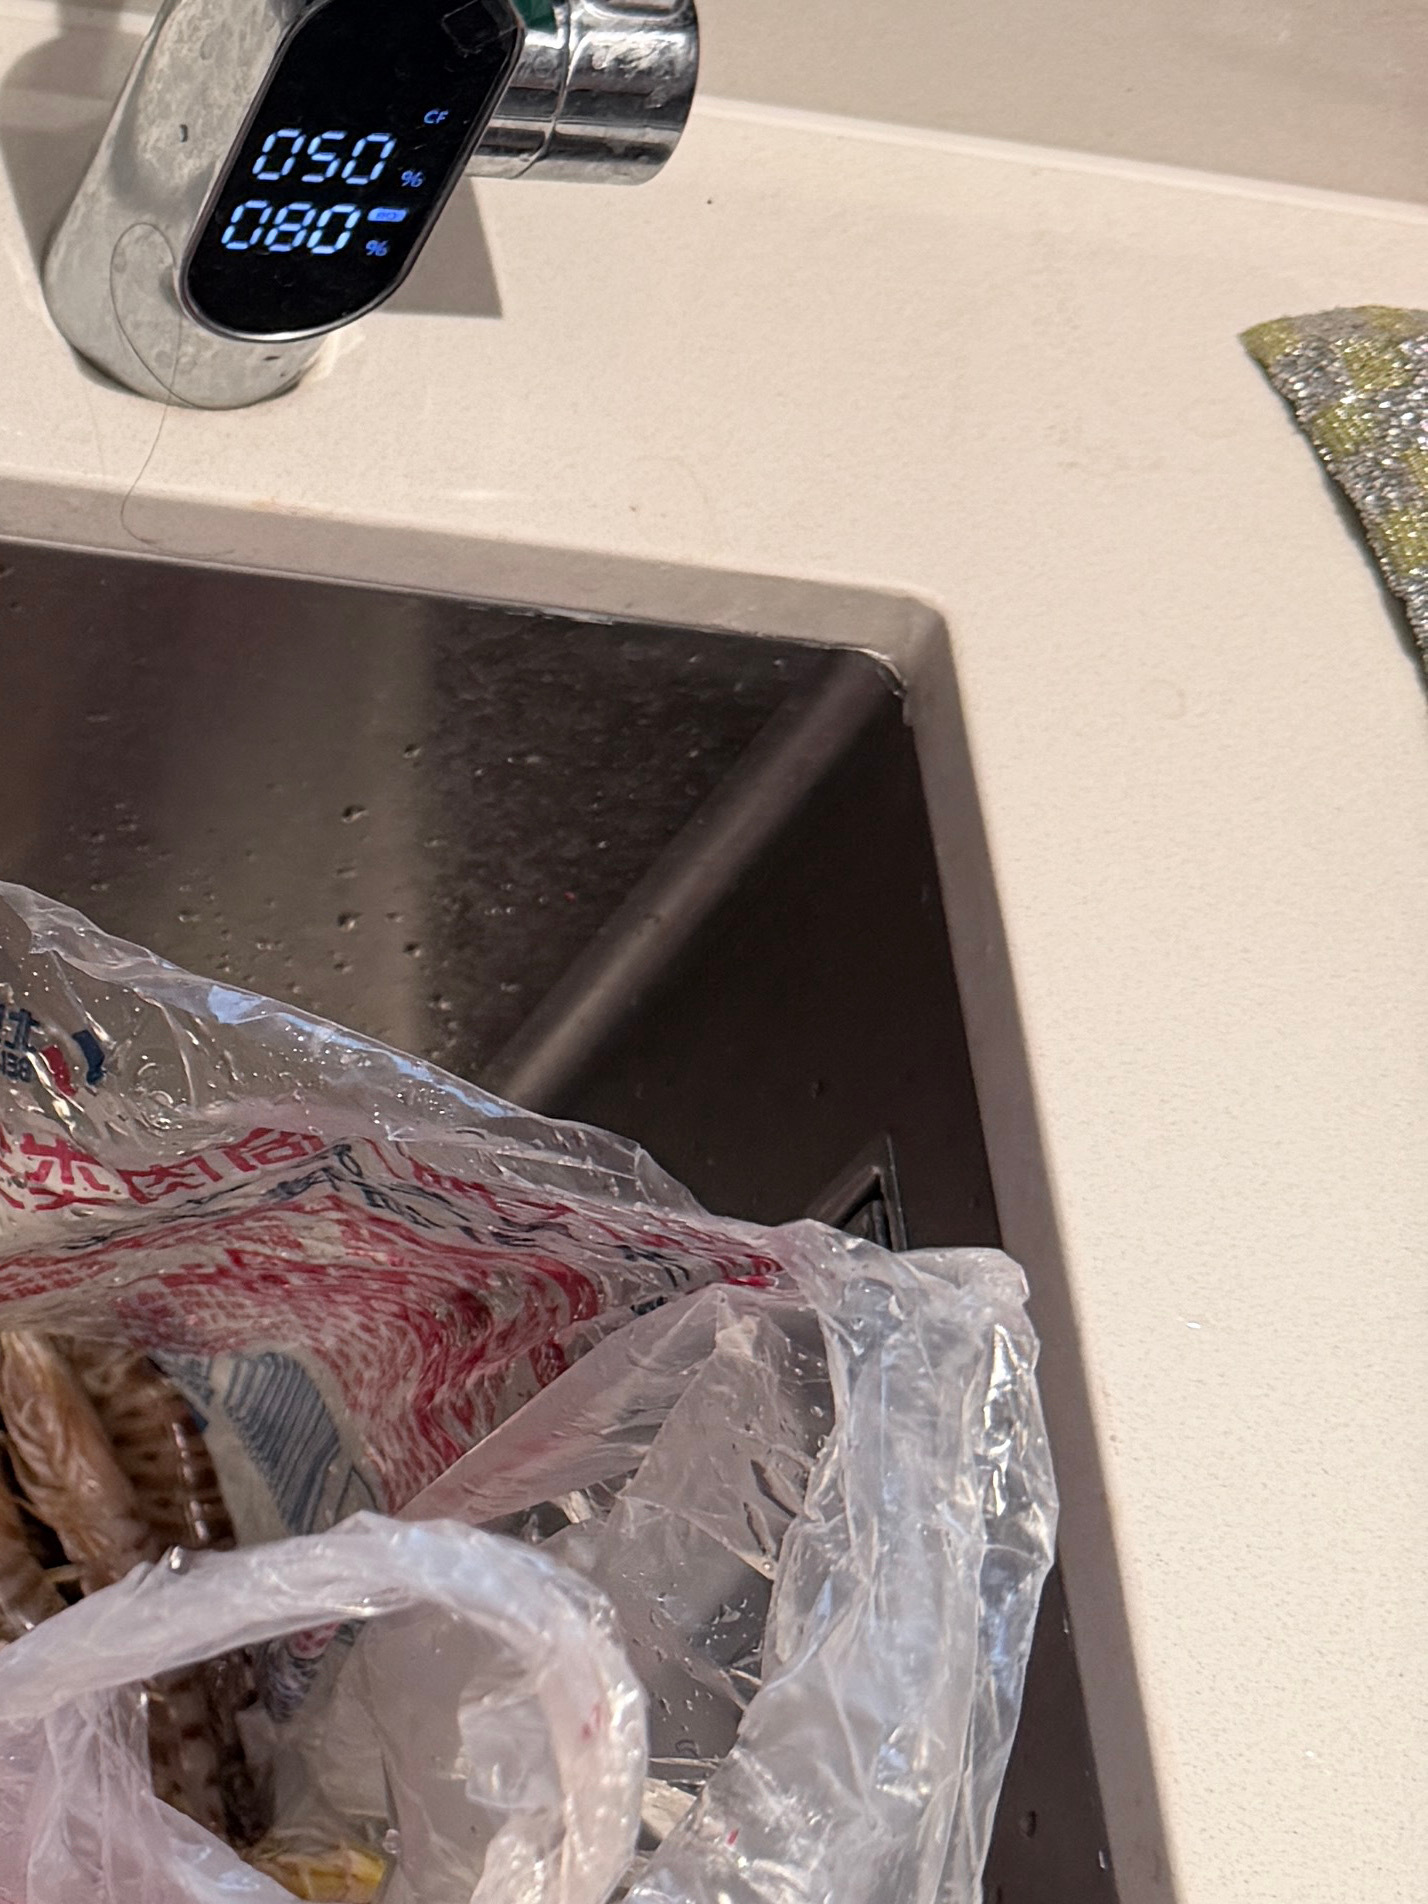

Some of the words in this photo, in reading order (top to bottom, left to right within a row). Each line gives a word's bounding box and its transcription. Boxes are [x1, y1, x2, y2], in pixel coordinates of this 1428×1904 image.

[423, 108, 449, 124] CF
[252, 128, 397, 185] 050
[221, 198, 362, 256] 080
